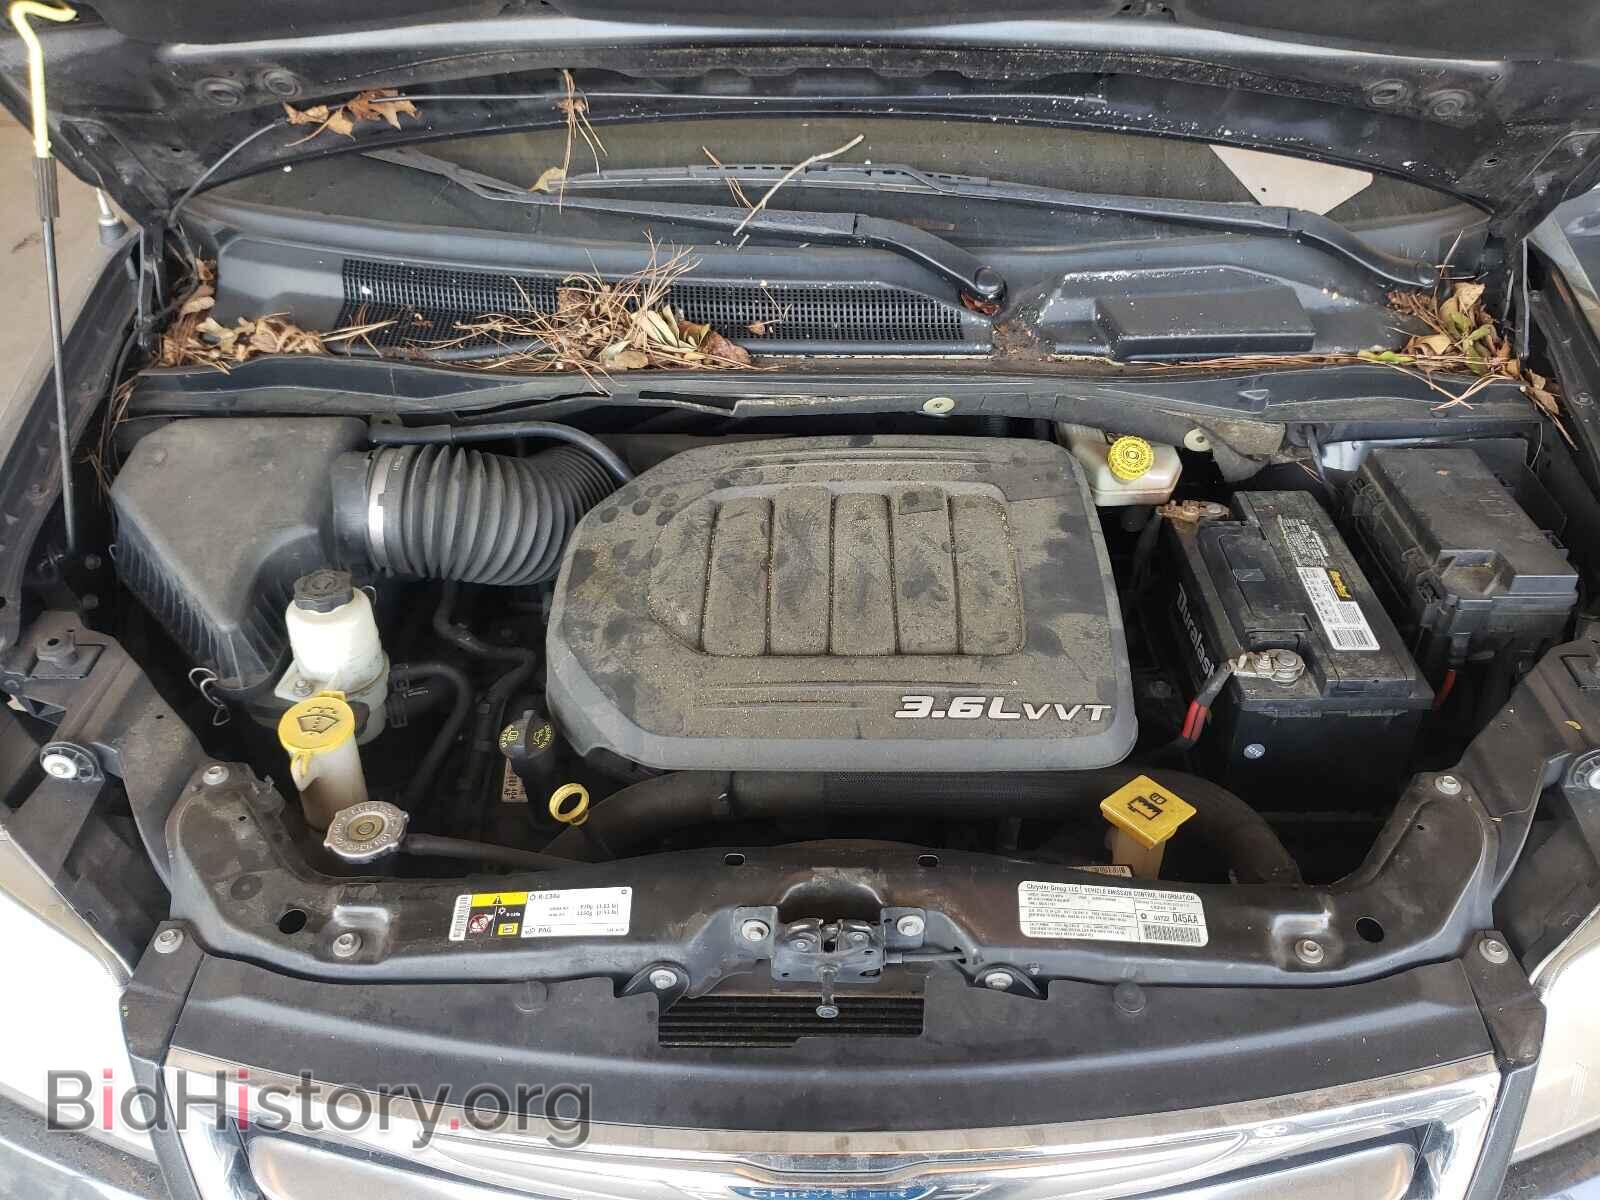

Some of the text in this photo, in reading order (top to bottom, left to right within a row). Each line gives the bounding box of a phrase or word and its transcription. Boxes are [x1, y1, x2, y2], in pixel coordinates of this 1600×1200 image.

[1177, 582, 1215, 679] Duralast
[894, 695, 1113, 721] 3.6L VVT
[1026, 883, 1049, 891] Chrysler
[1050, 885, 1067, 893] Group
[1158, 892, 1195, 900] INFORMATION
